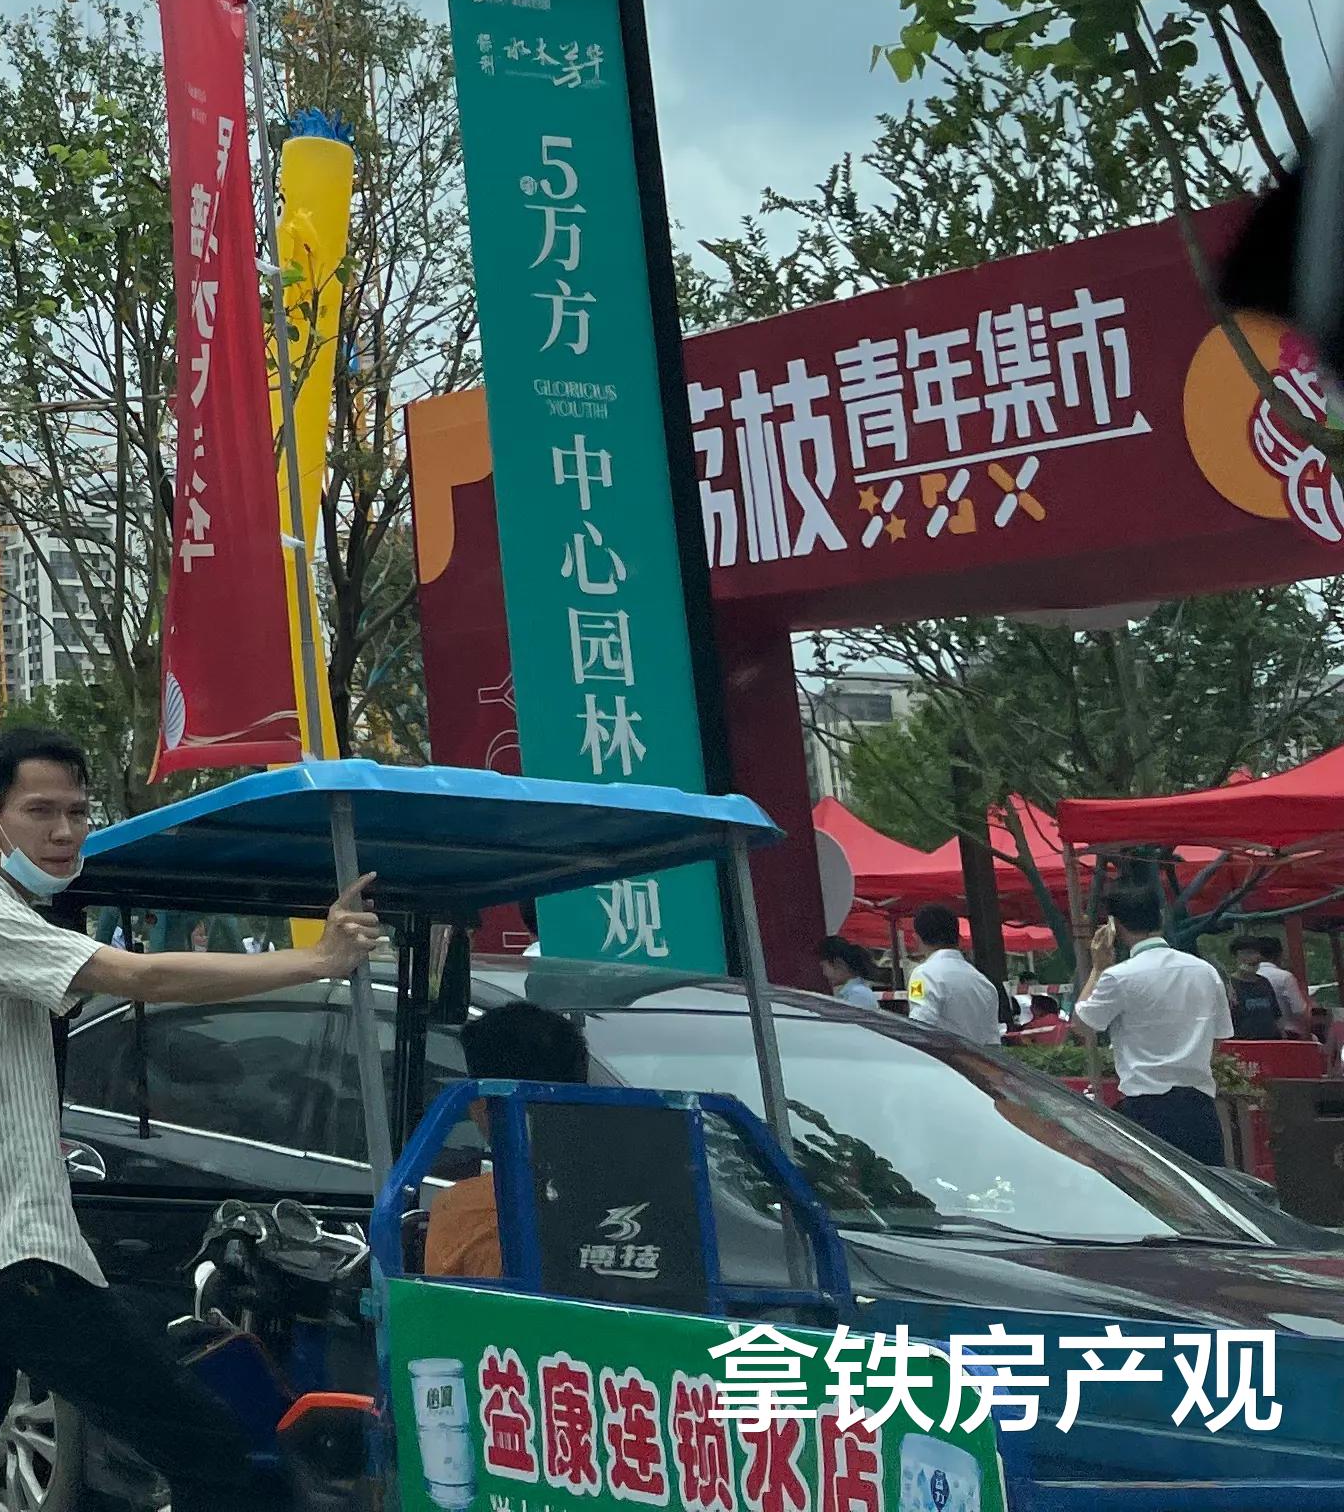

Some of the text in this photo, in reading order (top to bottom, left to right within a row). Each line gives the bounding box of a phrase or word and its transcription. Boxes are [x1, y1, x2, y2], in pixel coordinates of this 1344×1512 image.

[523, 135, 596, 355] 5万方
[533, 378, 618, 401] GLORIOUS
[549, 398, 608, 420] YOUTH
